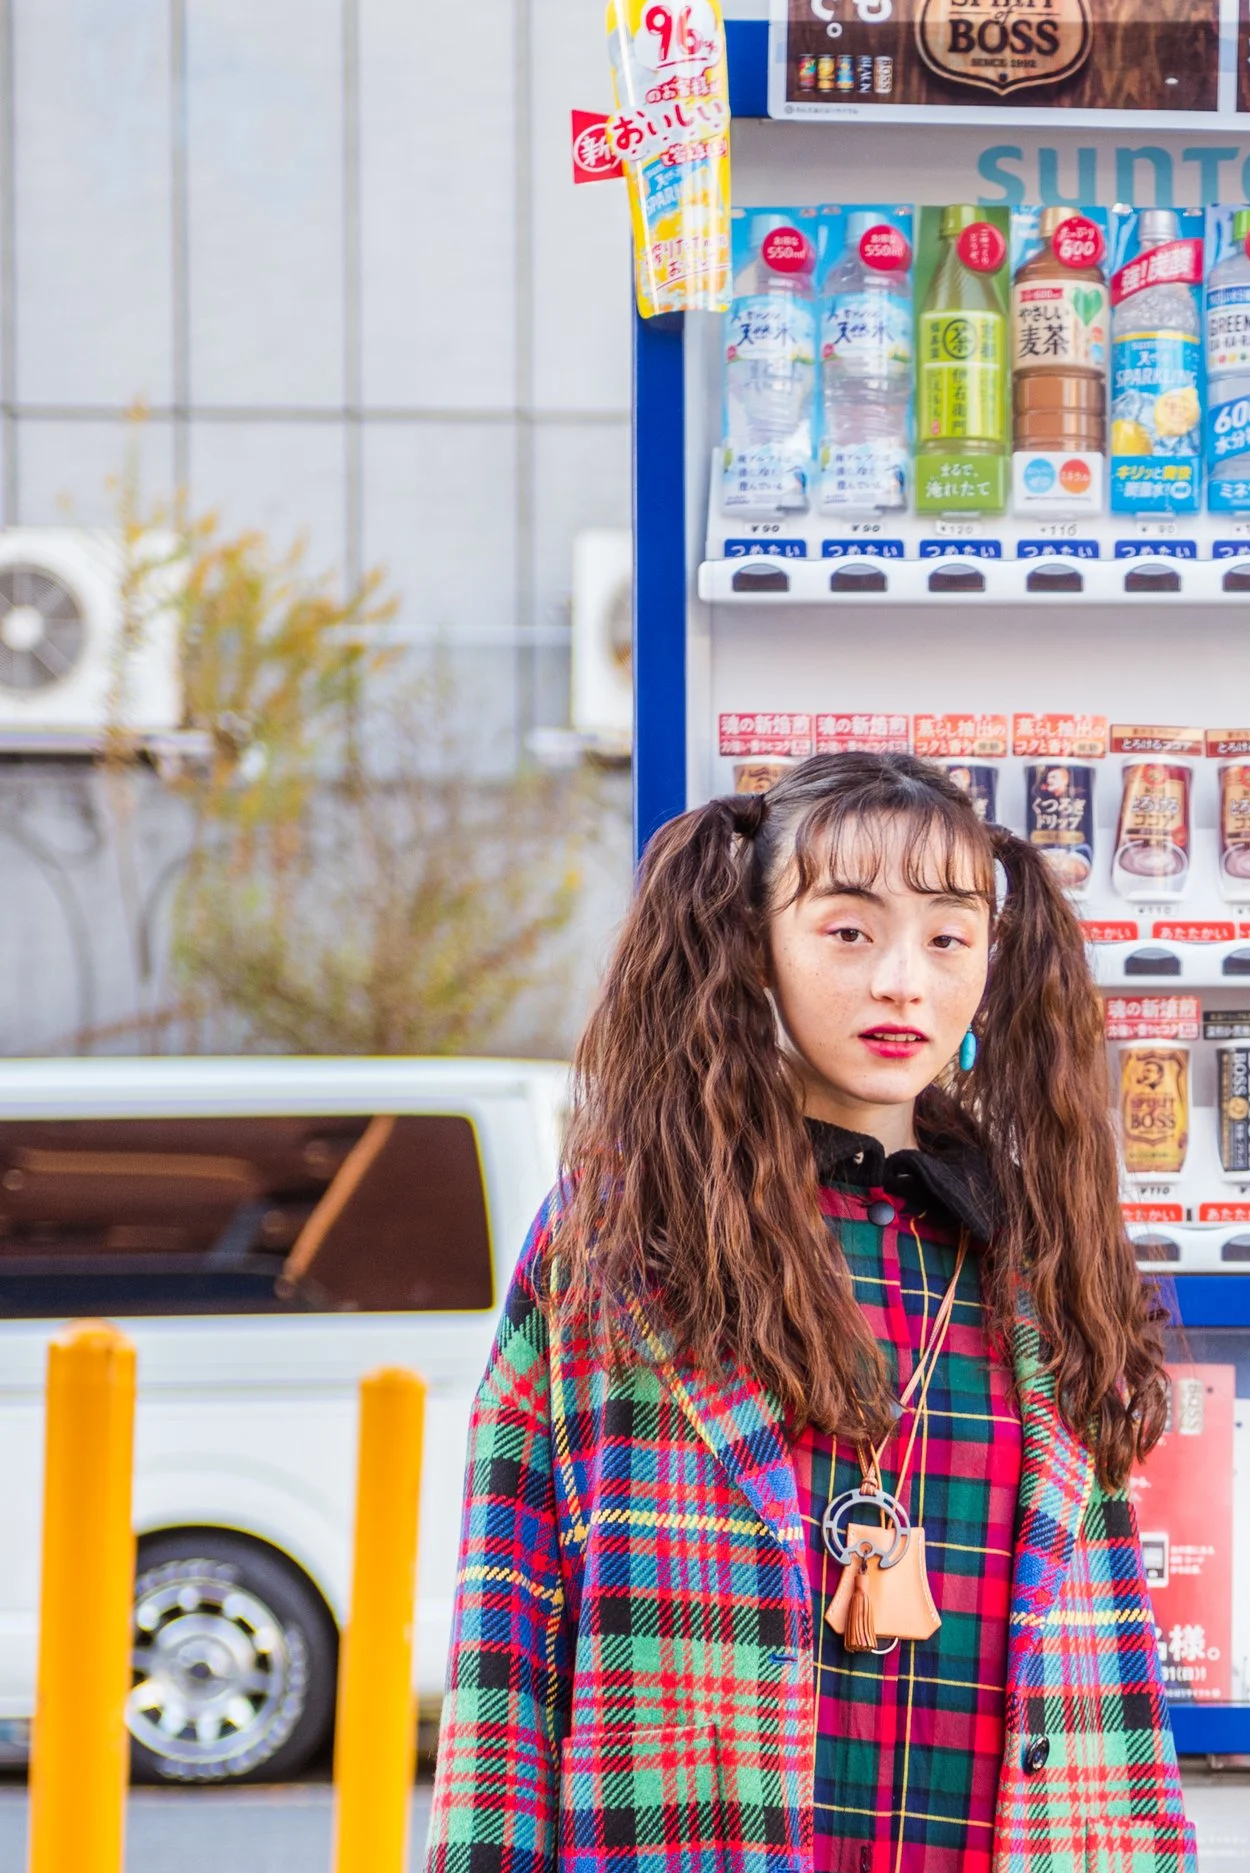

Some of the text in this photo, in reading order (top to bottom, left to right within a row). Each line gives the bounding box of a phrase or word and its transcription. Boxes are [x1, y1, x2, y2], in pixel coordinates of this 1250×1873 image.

[948, 18, 1060, 56] BOSS
[612, 103, 723, 150] おいしい
[767, 246, 806, 259] 550ml
[864, 245, 904, 258] 550ml
[1059, 239, 1096, 258] 600
[1019, 305, 1069, 323] やさしい
[1019, 324, 1069, 358] 麦茶
[925, 480, 991, 499] 淹れたて
[731, 544, 800, 557] つめたい
[828, 544, 898, 557] つめたい
[925, 544, 995, 557] つめたい
[1023, 545, 1094, 558] つめたい
[1120, 545, 1191, 558] つめたい
[1031, 798, 1086, 815] くつろぎ
[1036, 814, 1080, 831] ドリップ
[1160, 926, 1229, 940] あたたかい
[1232, 1052, 1248, 1097] BOSS
[1131, 1112, 1177, 1129] BOSS
